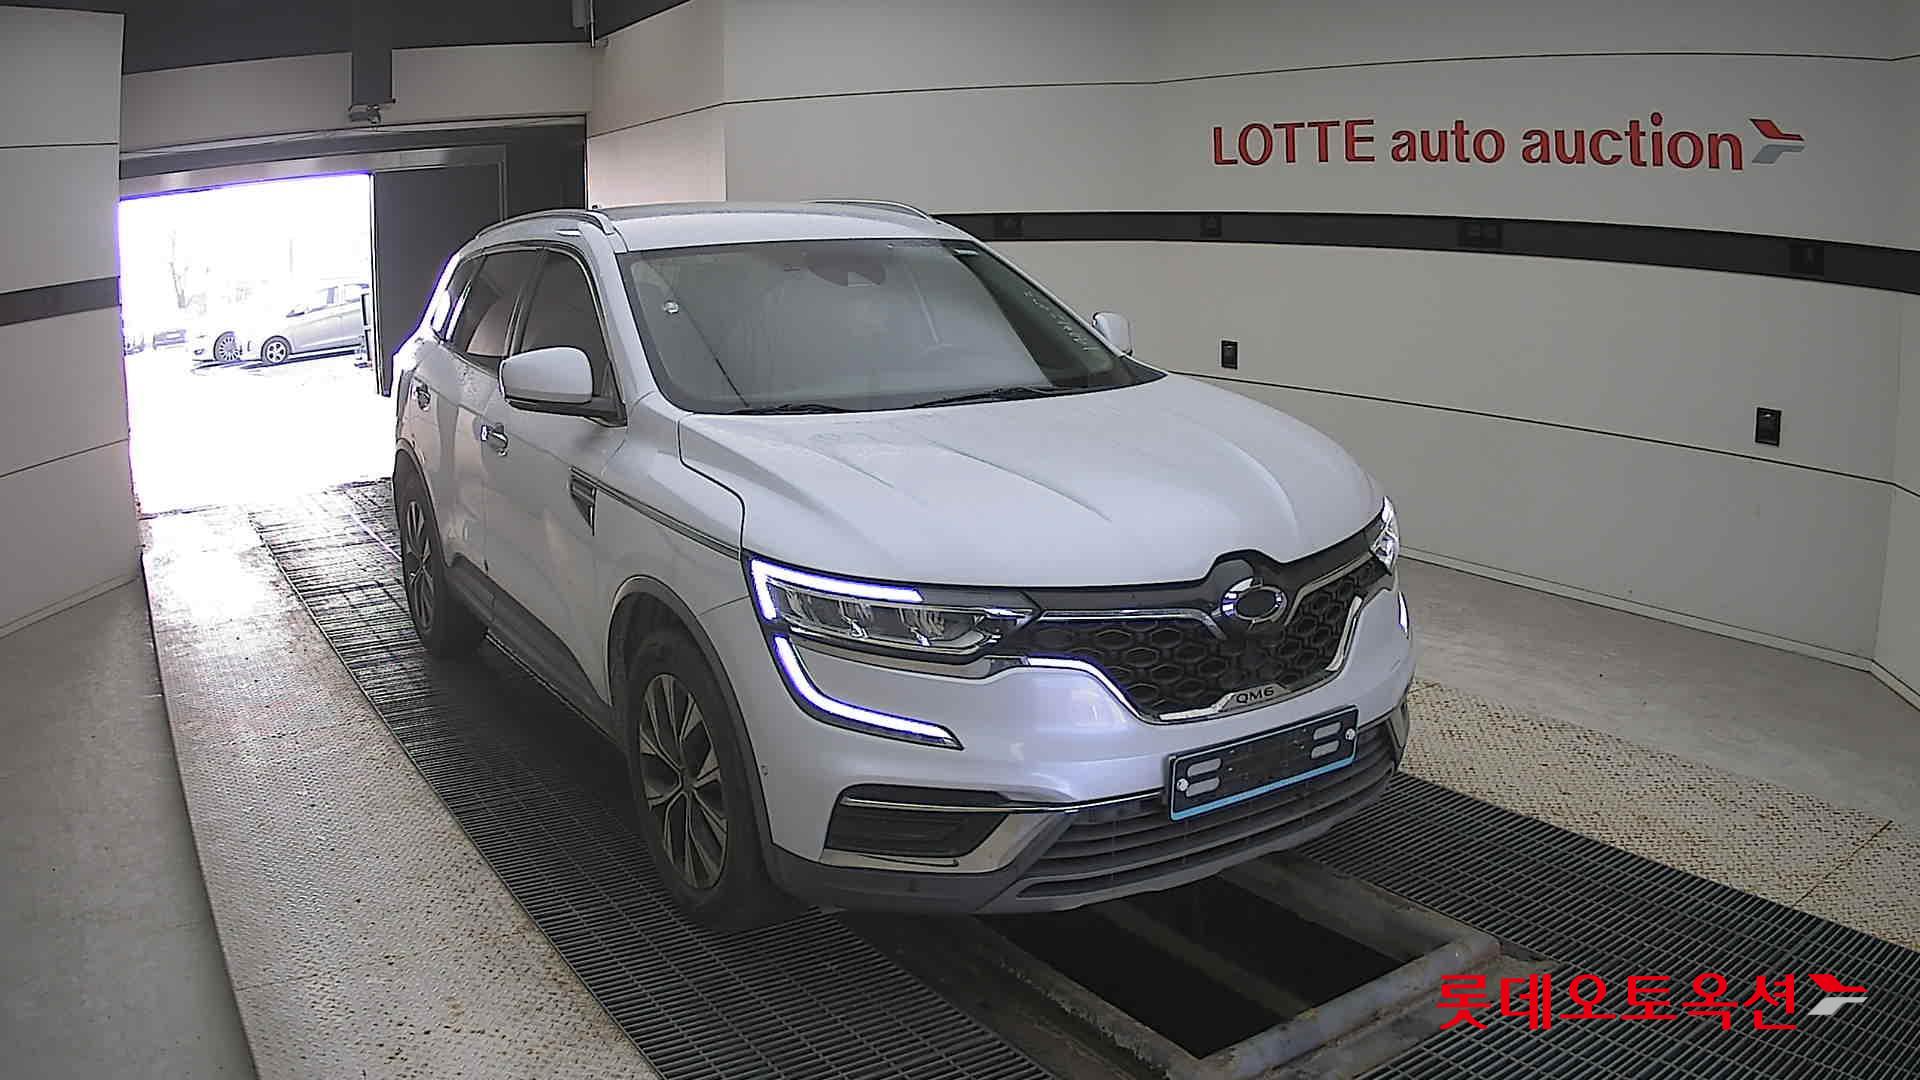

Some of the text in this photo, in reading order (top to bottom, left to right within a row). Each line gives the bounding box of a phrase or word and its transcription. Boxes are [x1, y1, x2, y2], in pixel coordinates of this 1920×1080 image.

[1213, 112, 1744, 171] LOTTE auto auction
[1236, 686, 1274, 703] QM6
